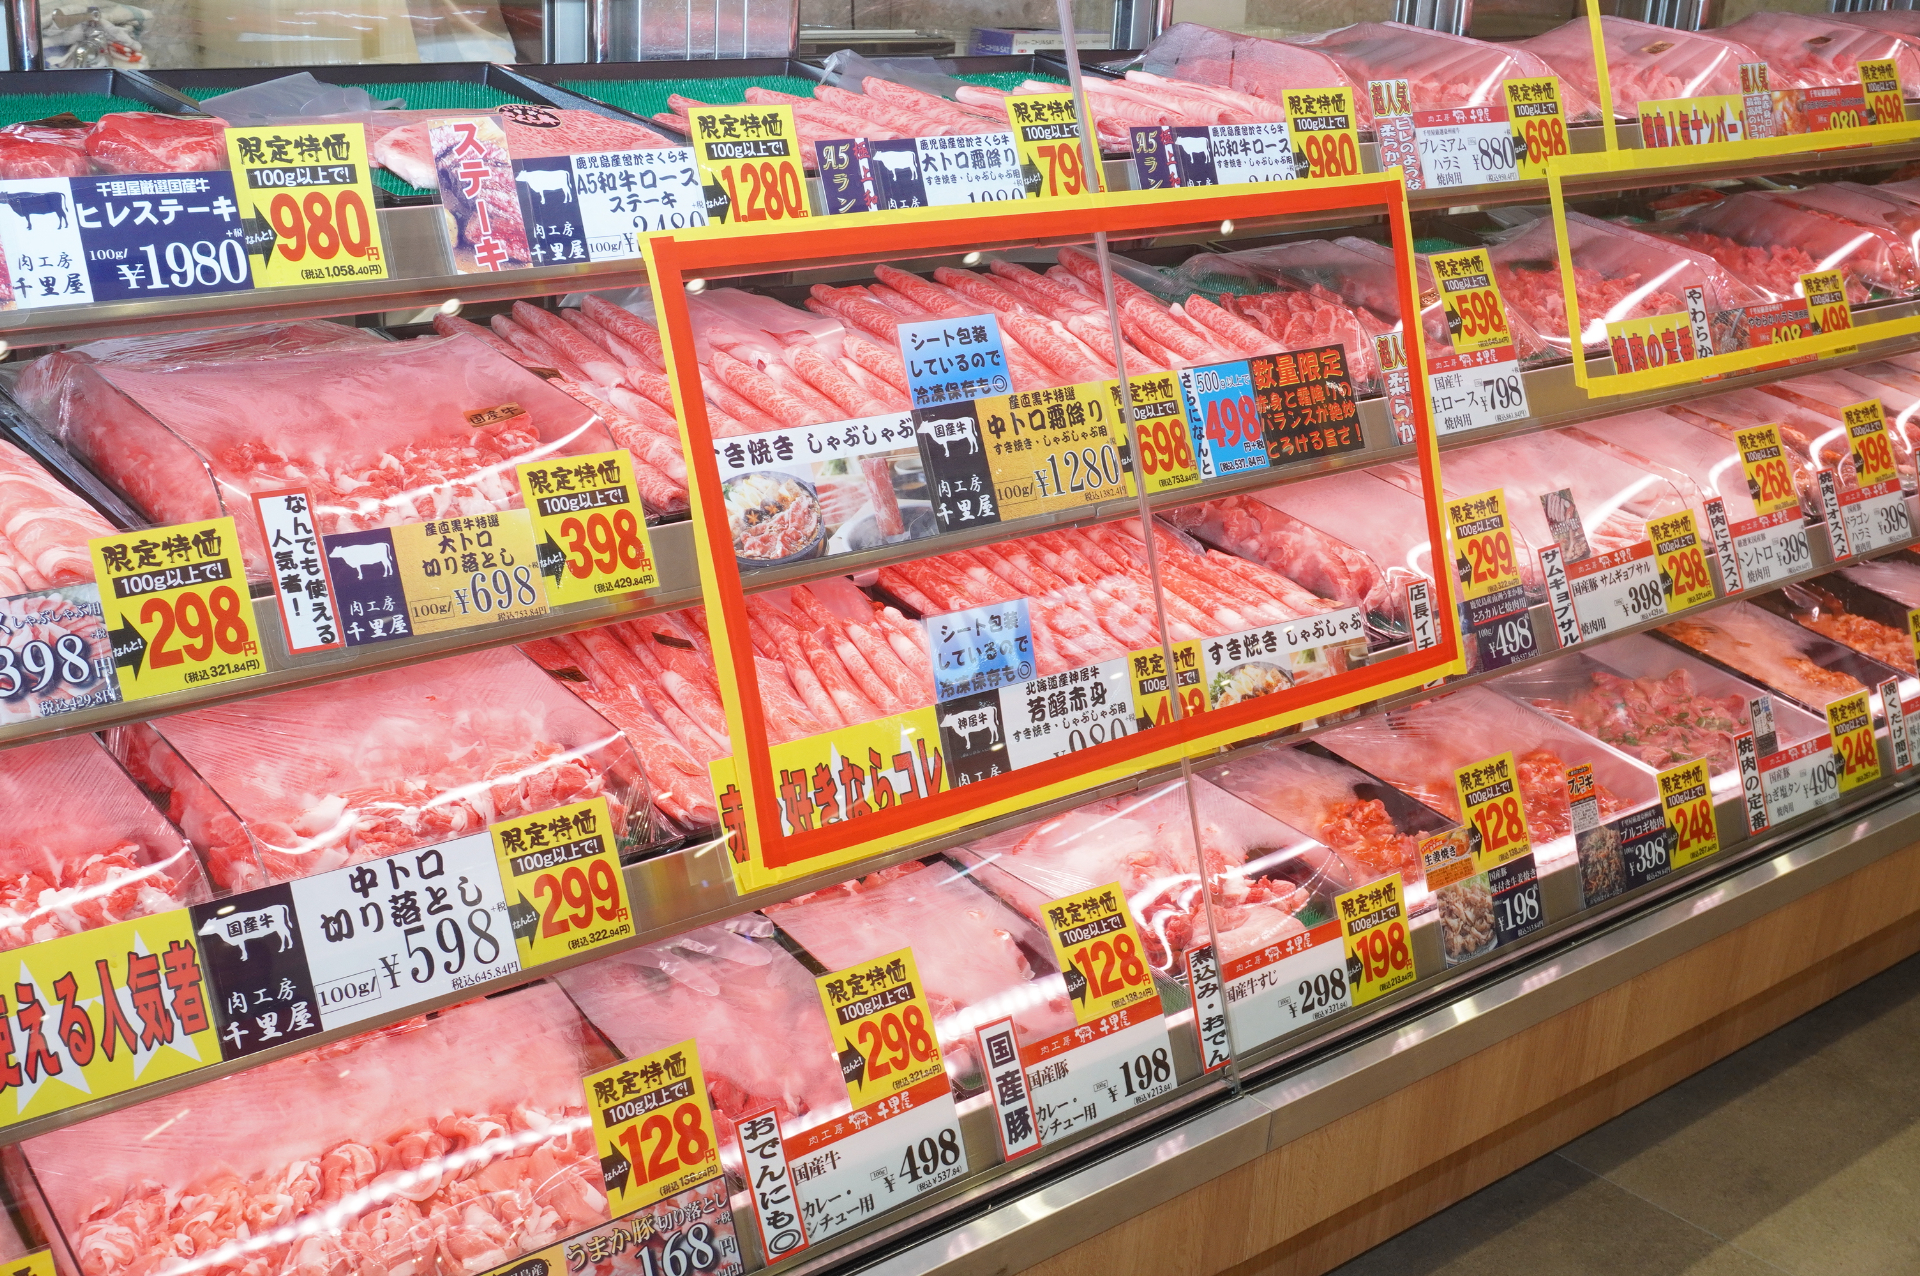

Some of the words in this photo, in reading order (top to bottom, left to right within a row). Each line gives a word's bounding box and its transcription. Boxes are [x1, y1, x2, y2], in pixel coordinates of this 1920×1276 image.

[1289, 93, 1346, 115] 限定特価
[1371, 81, 1411, 116] 超人気
[1509, 82, 1554, 102] 限定特価
[1297, 117, 1346, 130] 100g以上で!
[1516, 103, 1557, 115] 100g以上で!
[697, 114, 783, 140] 限定特価
[237, 133, 350, 165] 限定特価
[710, 142, 784, 158] 100g以上で!
[922, 148, 1016, 172] 大トロ霜降り
[1214, 138, 1290, 157] A5和牛ロース
[1396, 119, 1422, 190] ヒレのような
[1420, 139, 1467, 154] プレミアム
[1473, 137, 1516, 170] ¥880
[254, 166, 350, 187] 100g以上で!
[1434, 158, 1461, 170] ハラミ
[1437, 172, 1462, 185] 焼肉用
[96, 178, 210, 196] 千里屋厳選国産牛
[578, 168, 698, 195] A5和牛ロース
[453, 121, 507, 272] ステーキ
[609, 191, 677, 212] ステーキ
[76, 196, 237, 229] ヒレステーキ
[533, 223, 574, 237] 肉工房
[17, 252, 72, 270] 肉工房
[118, 241, 248, 289] ¥1980
[530, 243, 585, 261] 千里屋
[1436, 256, 1484, 278] 限定特価
[13, 273, 86, 299] 千里屋
[1445, 276, 1488, 291] 100g以上で!
[1804, 275, 1839, 293] 限定特価
[910, 326, 989, 350] シート包装
[910, 350, 1000, 378] しているので
[1252, 350, 1344, 390] 数量限定
[1197, 373, 1250, 394] 500g以上で
[1434, 374, 1463, 391] 国産牛
[1481, 375, 1522, 412] ¥798
[1008, 386, 1075, 409] 産直黒牛特選
[1255, 382, 1352, 414] 赤身と霜降りの
[469, 405, 517, 424] 国産牛
[987, 399, 1103, 439] 中トロ霜降り
[1181, 372, 1212, 475] さらになんと
[1206, 396, 1262, 448] 498
[1261, 403, 1355, 431] バランスが絶妙
[1445, 414, 1472, 430] 焼肉用
[1845, 405, 1879, 425] 限定特価
[807, 418, 913, 454] しゃぶしゃぶ
[934, 422, 966, 438] 国産牛
[993, 427, 1107, 455] すき焼き・しゃぶしゃぶ用
[1268, 423, 1361, 458] とろける旨さ!
[1738, 432, 1775, 450] 限定特価
[527, 460, 621, 496] 限定特価
[1034, 444, 1119, 498] ¥1280
[543, 489, 623, 512] 100g以上で!
[938, 474, 983, 498] 肉工房
[936, 494, 996, 523] 千里屋
[1451, 495, 1499, 524] 限定特価
[1819, 472, 1847, 557] 焼肉にオススメ
[1844, 512, 1870, 529] ドラゴン
[1878, 503, 1908, 535] ¥398
[425, 515, 500, 538] 産直黒牛特選
[1459, 517, 1500, 536] 100g以上で!
[1651, 516, 1691, 541] 限定特価
[1852, 527, 1871, 540] ハラミ
[102, 529, 221, 574] 限定特価
[439, 530, 493, 554] 大トロ
[1659, 533, 1694, 553] 100g以上で!
[1707, 500, 1739, 592] 焼肉にオススメ
[1777, 532, 1808, 566] ¥398
[285, 495, 335, 645] なんでも使える
[422, 547, 515, 576] 切り落とし
[1737, 544, 1773, 570] トントロ
[121, 564, 223, 596] 100g以上で!
[272, 530, 302, 617] 人気者!
[593, 575, 654, 594] (税込429.84円)
[1572, 579, 1598, 597] 国産豚
[1600, 563, 1650, 584] サムギョプサル
[1748, 566, 1771, 583] 焼肉用
[454, 566, 536, 615] ¥698
[1542, 550, 1579, 648] サムギョプサル
[1623, 580, 1662, 617] ¥398
[13, 602, 100, 628] しゃぶしゃぶ用
[349, 597, 395, 616] 肉工房
[1473, 597, 1526, 622] とろカルビ焼肉用
[346, 615, 408, 640] 千里屋
[940, 611, 1019, 642] シート包装
[1208, 631, 1277, 665] すき焼き
[1287, 612, 1363, 646] しゃぶしゃぶ
[1489, 618, 1532, 658] ¥498
[1581, 617, 1606, 637] 焼肉用
[938, 636, 1028, 670] しているので
[184, 659, 260, 684] (税込321.84円)
[1026, 665, 1100, 696] 北海道産神居牛
[1027, 681, 1108, 723] 芳醇赤身
[1829, 698, 1865, 723] 限定特価
[958, 714, 988, 730] 神居牛
[1012, 702, 1127, 742] すき焼き・しゃぶしゃぶ用
[1883, 682, 1909, 767] 焼くだけ簡単
[1460, 759, 1508, 792] 限定特価
[1568, 774, 1593, 795] ブルコギ
[1661, 765, 1702, 794] 限定特価
[1738, 735, 1767, 830] 焼肉の定番
[1803, 761, 1836, 799] ¥498
[1468, 783, 1511, 805] 100g以上で!
[1765, 782, 1800, 805] ねぎ塩タン
[500, 809, 597, 854] 限定特価
[1621, 815, 1665, 842] ブルコギ焼肉
[515, 839, 599, 872] 100g以上で!
[1425, 846, 1456, 866] 生姜焼き
[350, 850, 444, 897] 中トロ
[1491, 869, 1536, 895] 味付き生姜焼き
[321, 876, 483, 943] 切り落とし
[1048, 891, 1117, 931] 限定特価
[1342, 883, 1396, 920] 限定特価
[226, 914, 273, 937] 国産牛
[1064, 918, 1121, 944] 100g以上で!
[1351, 908, 1397, 933] 100g以上で!
[379, 910, 500, 991] ¥598
[568, 924, 630, 951] (税込322.94円)
[451, 961, 519, 990] 税込645.84円
[826, 958, 906, 1006] 限定特価
[1226, 970, 1278, 1003] 国産牛すじ
[227, 978, 297, 1014] 肉工房
[842, 988, 910, 1022] 100g以上で!
[1289, 968, 1346, 1018] ¥298
[223, 1001, 314, 1050] 千里屋
[1100, 1011, 1130, 1034] 千里屋
[593, 1051, 687, 1107] 限定特価
[986, 1031, 1032, 1145] 国産豚
[1027, 1060, 1069, 1091] 国産豚
[609, 1083, 689, 1123] 100g以上で!
[877, 1091, 913, 1120] 千里屋
[1039, 1103, 1097, 1140] シチュー用
[791, 1150, 841, 1186] 国産牛
[806, 1194, 875, 1239] シチュー用
[567, 1213, 655, 1271] うまか豚
